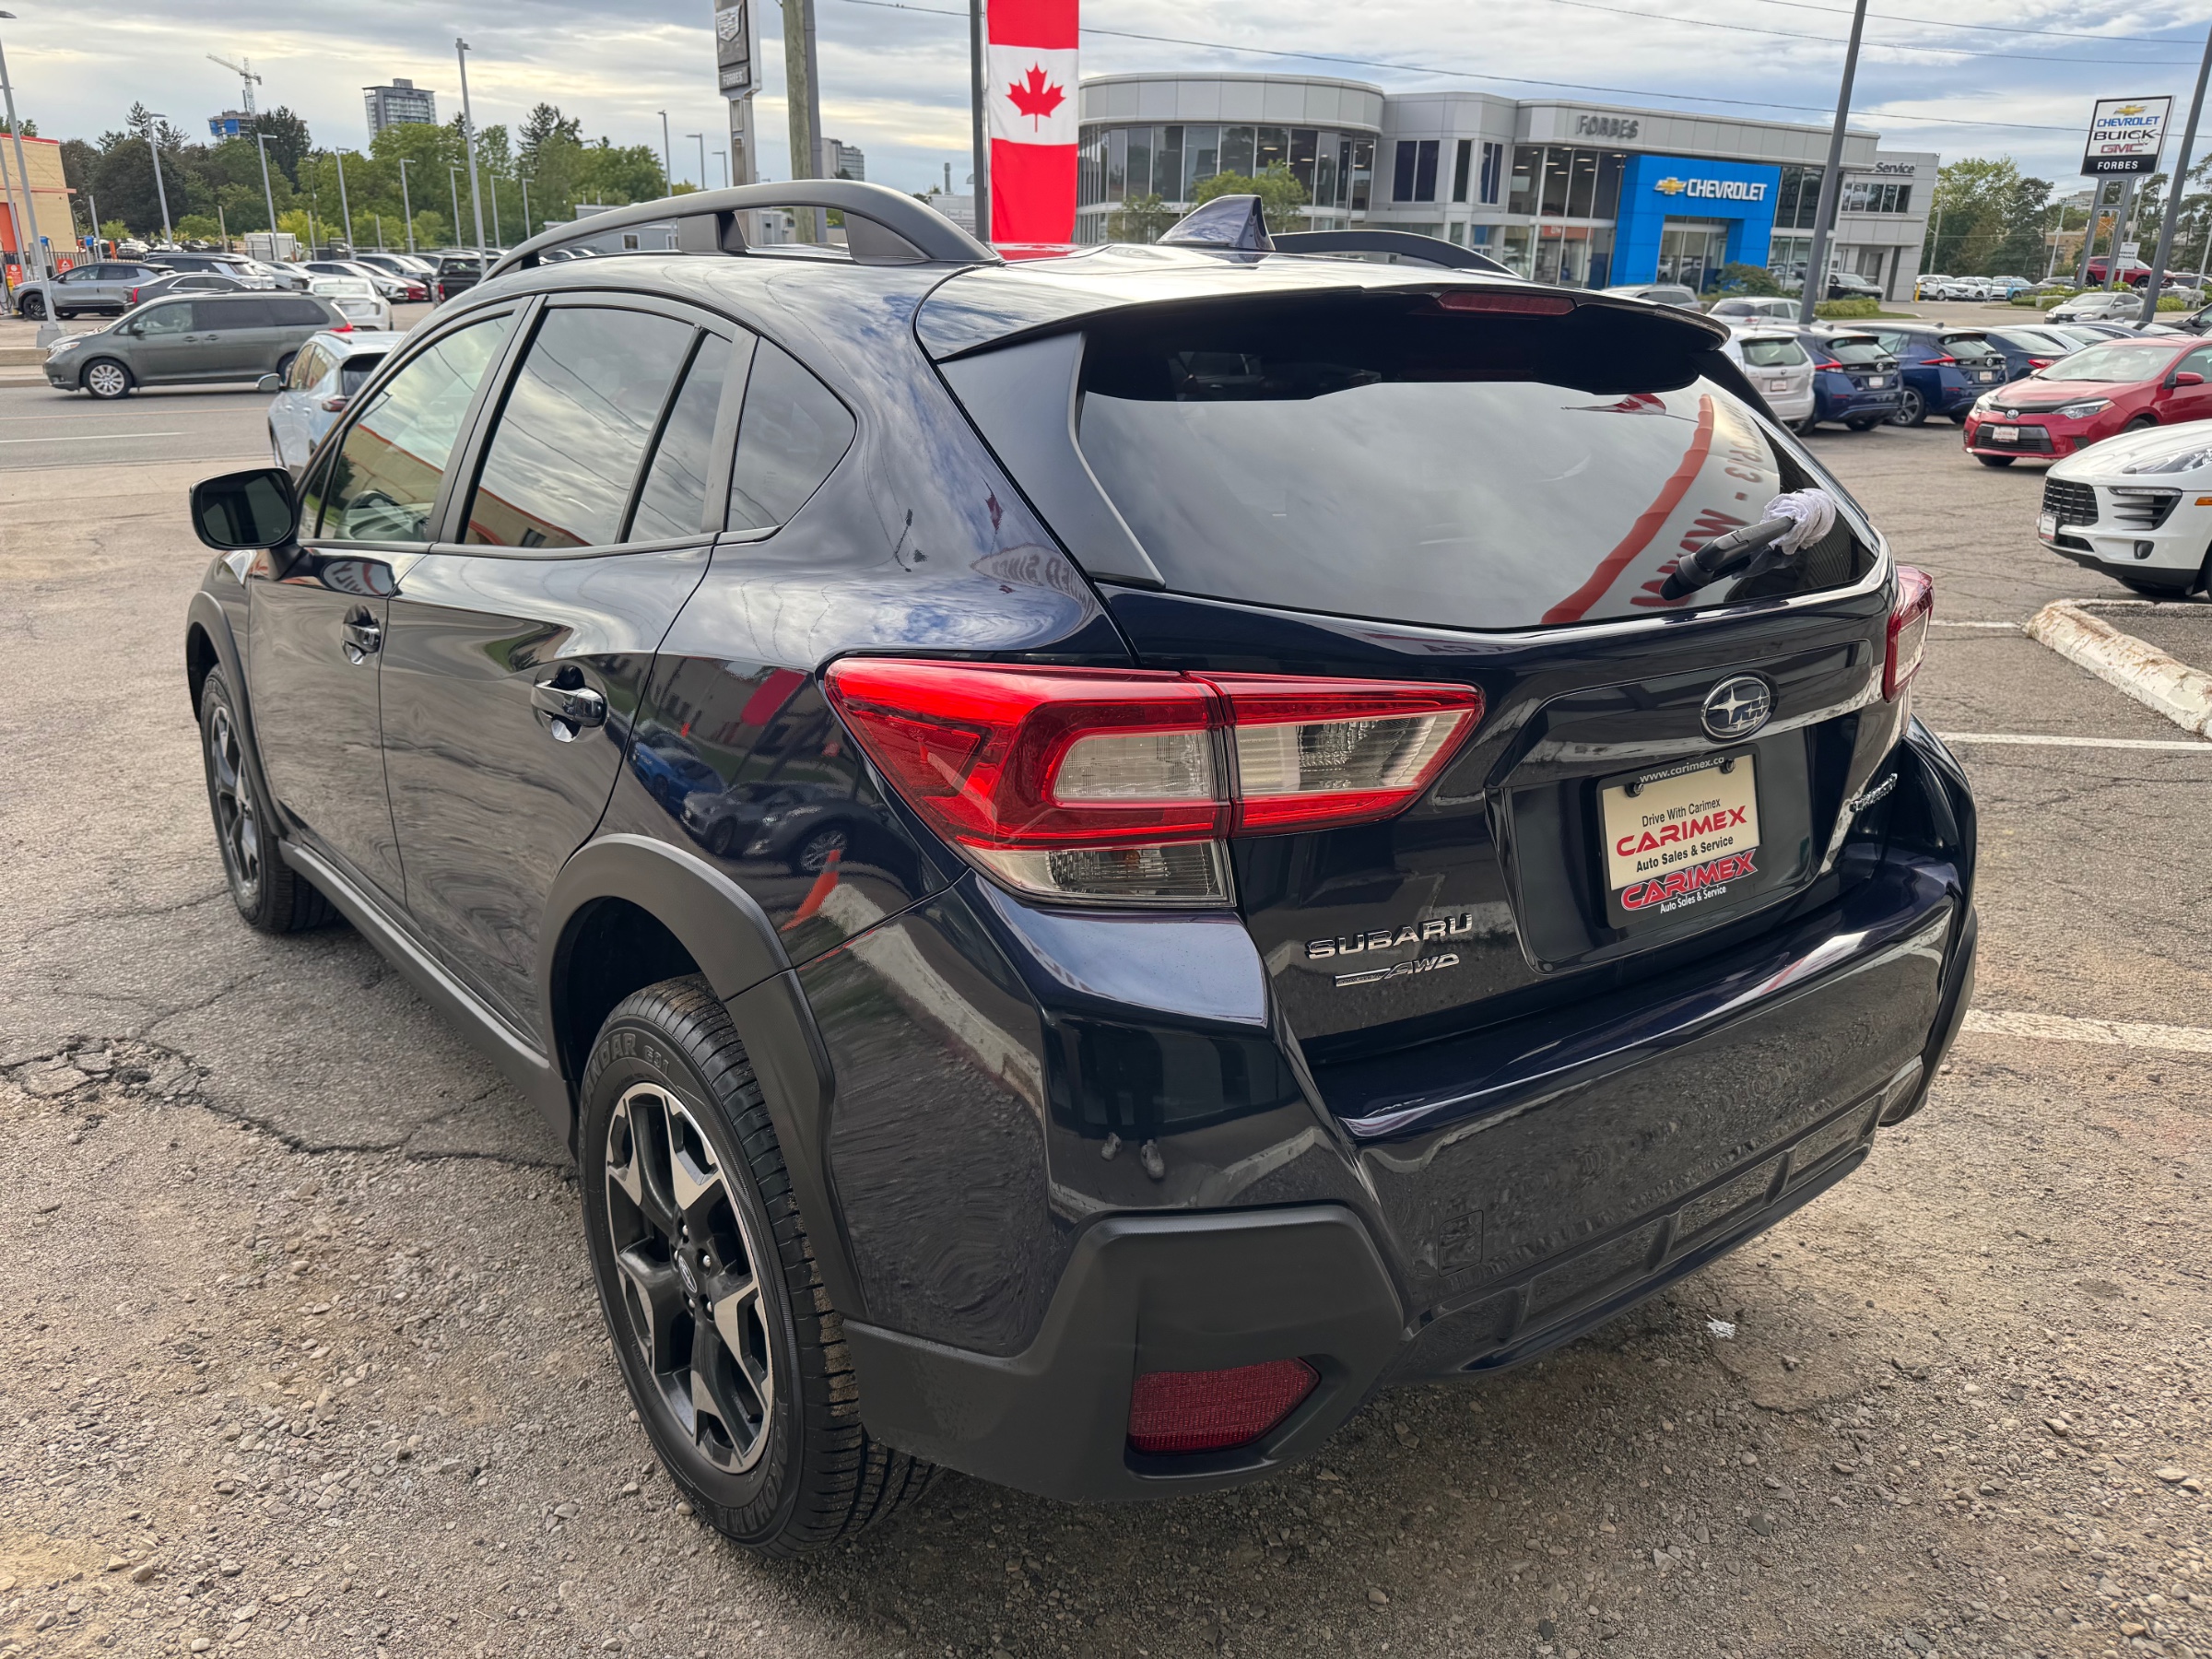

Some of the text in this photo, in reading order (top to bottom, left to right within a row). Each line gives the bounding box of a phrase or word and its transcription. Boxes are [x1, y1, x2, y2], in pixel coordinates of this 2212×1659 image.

[1576, 115, 1639, 139] FORBES
[2093, 129, 2157, 140] BUICK
[2097, 116, 2160, 127] CHEVROLET
[2100, 143, 2144, 154] GMC
[1876, 162, 1914, 174] Service
[2098, 160, 2138, 170] FORBES
[1687, 179, 1768, 202] CHEVROLET
[1640, 756, 1724, 782] www.carimex.ca
[1641, 798, 1722, 828] Drive With Carimex
[1616, 805, 1747, 857] CARIMEX
[1636, 835, 1734, 873] Auto Sales & Service
[1621, 850, 1758, 911] CARIMEX
[1660, 885, 1727, 915] Auto Sales & Service
[1305, 912, 1472, 959] SUBARU
[1382, 952, 1460, 979] AWD
[714, 1397, 789, 1534] YOKOHAMA
